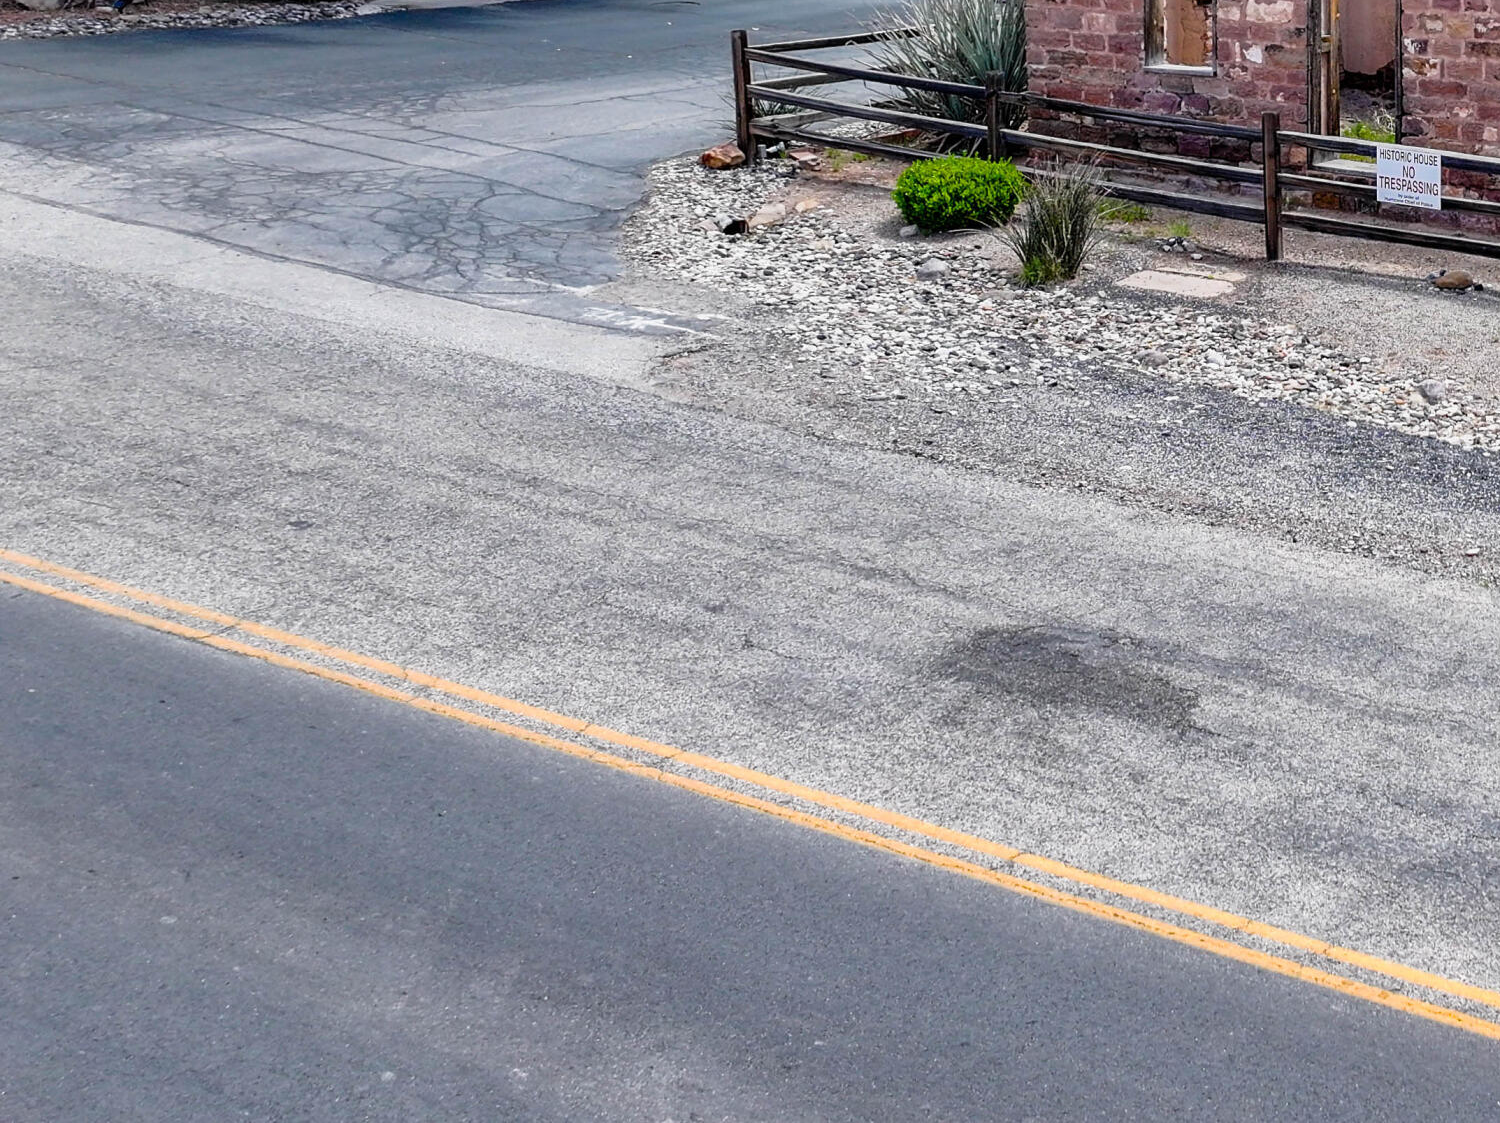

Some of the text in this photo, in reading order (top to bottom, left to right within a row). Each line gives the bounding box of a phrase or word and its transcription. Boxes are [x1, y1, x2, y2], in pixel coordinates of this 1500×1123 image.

[1380, 149, 1438, 166] HISTORIC HOUSE
[1402, 165, 1416, 179] NO
[1379, 176, 1439, 196] TRESPASSING
